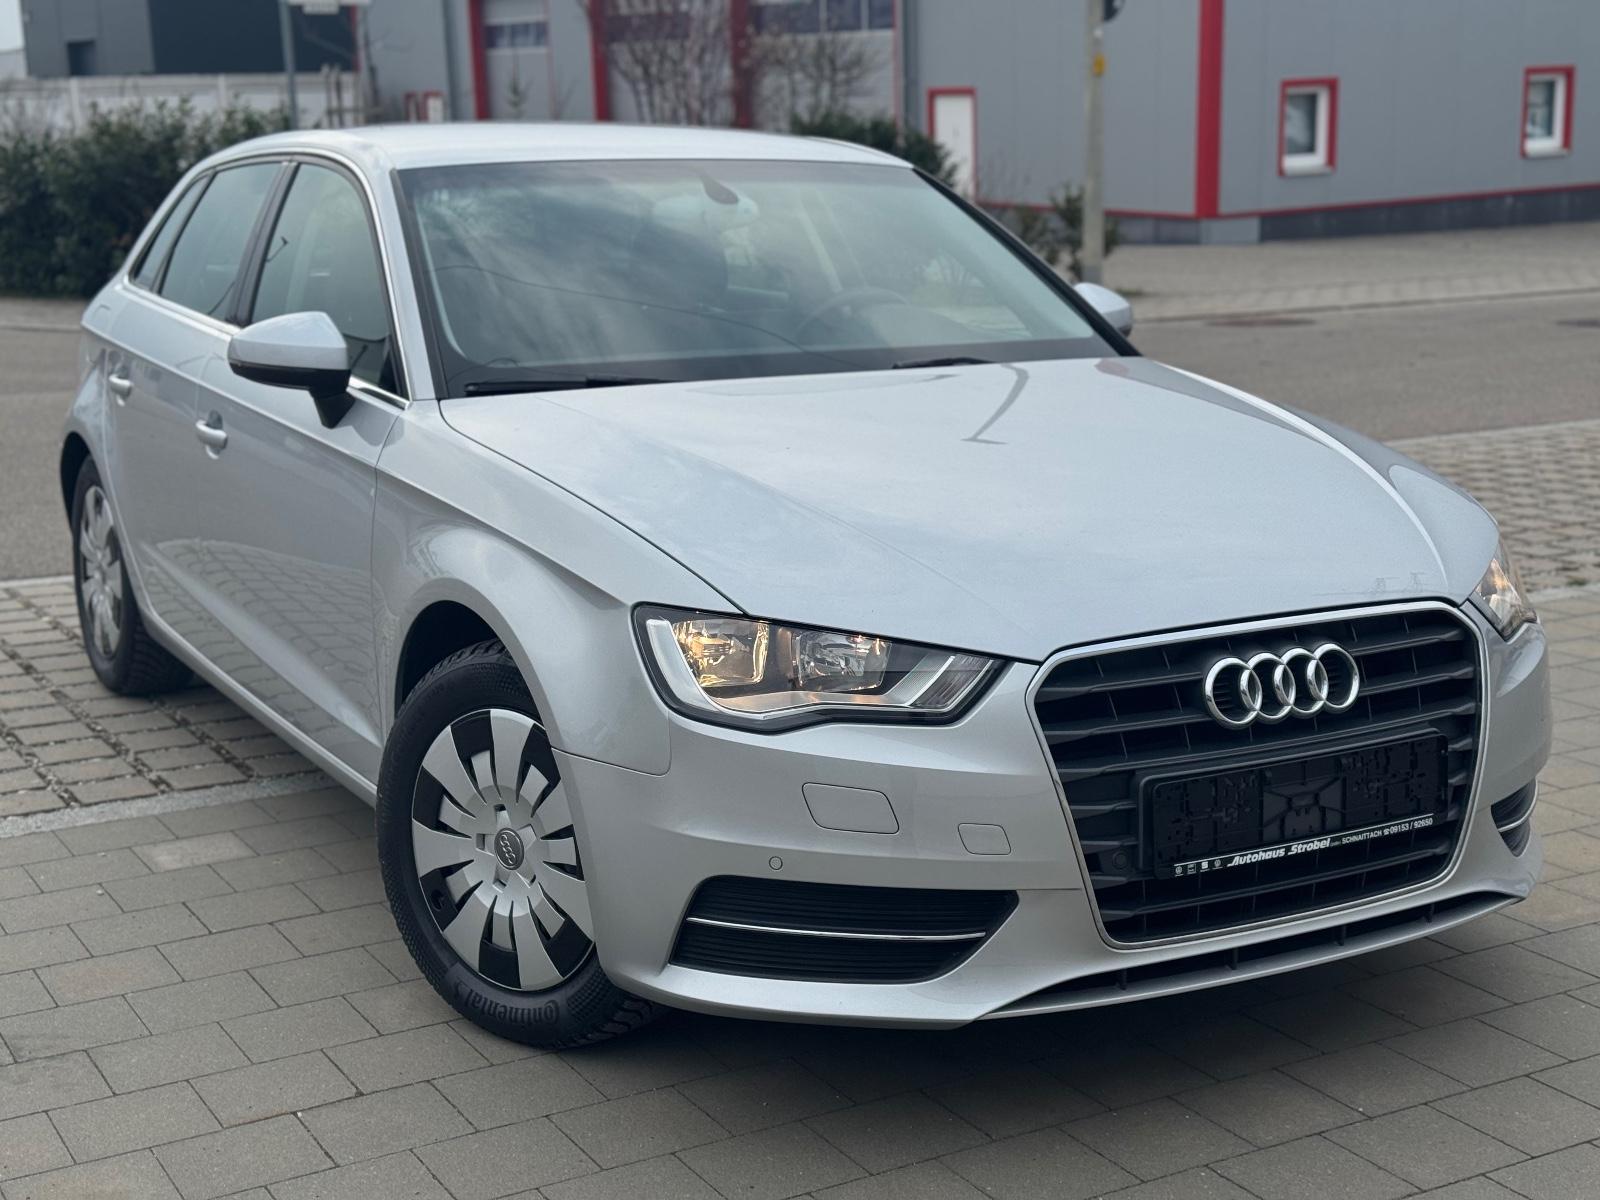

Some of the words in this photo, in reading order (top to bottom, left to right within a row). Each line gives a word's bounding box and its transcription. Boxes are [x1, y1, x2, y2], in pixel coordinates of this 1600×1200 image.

[1227, 848, 1286, 867] Autohaus
[1288, 838, 1331, 856] Strobel
[1390, 822, 1409, 834] 09153
[464, 988, 560, 1026] Continental
